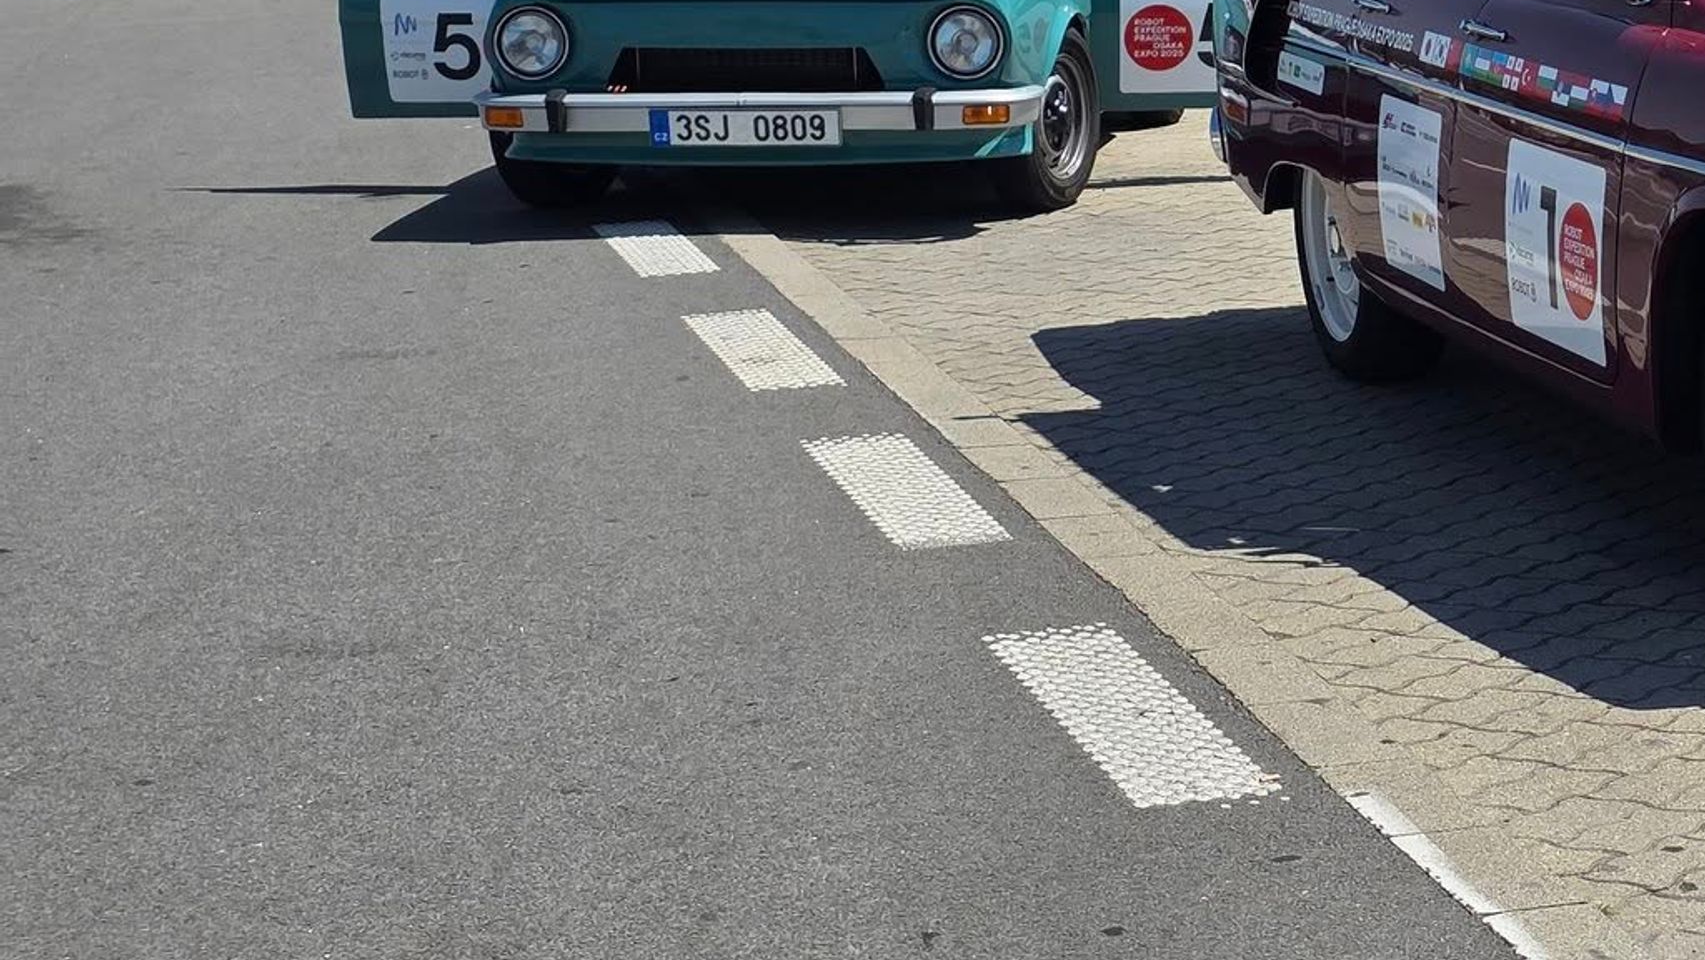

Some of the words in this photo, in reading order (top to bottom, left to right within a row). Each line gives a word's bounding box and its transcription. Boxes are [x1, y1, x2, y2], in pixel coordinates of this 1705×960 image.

[1134, 18, 1164, 26] ROBOT
[1134, 26, 1187, 34] EXPEDITION
[1134, 34, 1171, 42] PRAGUE
[433, 12, 481, 81] 5
[1153, 42, 1184, 50] OSAKA
[1134, 50, 1159, 58] EXPO
[1160, 50, 1184, 58] 2025
[654, 132, 668, 142] CZ
[676, 114, 730, 141] 3SJ
[753, 114, 826, 141] 0809
